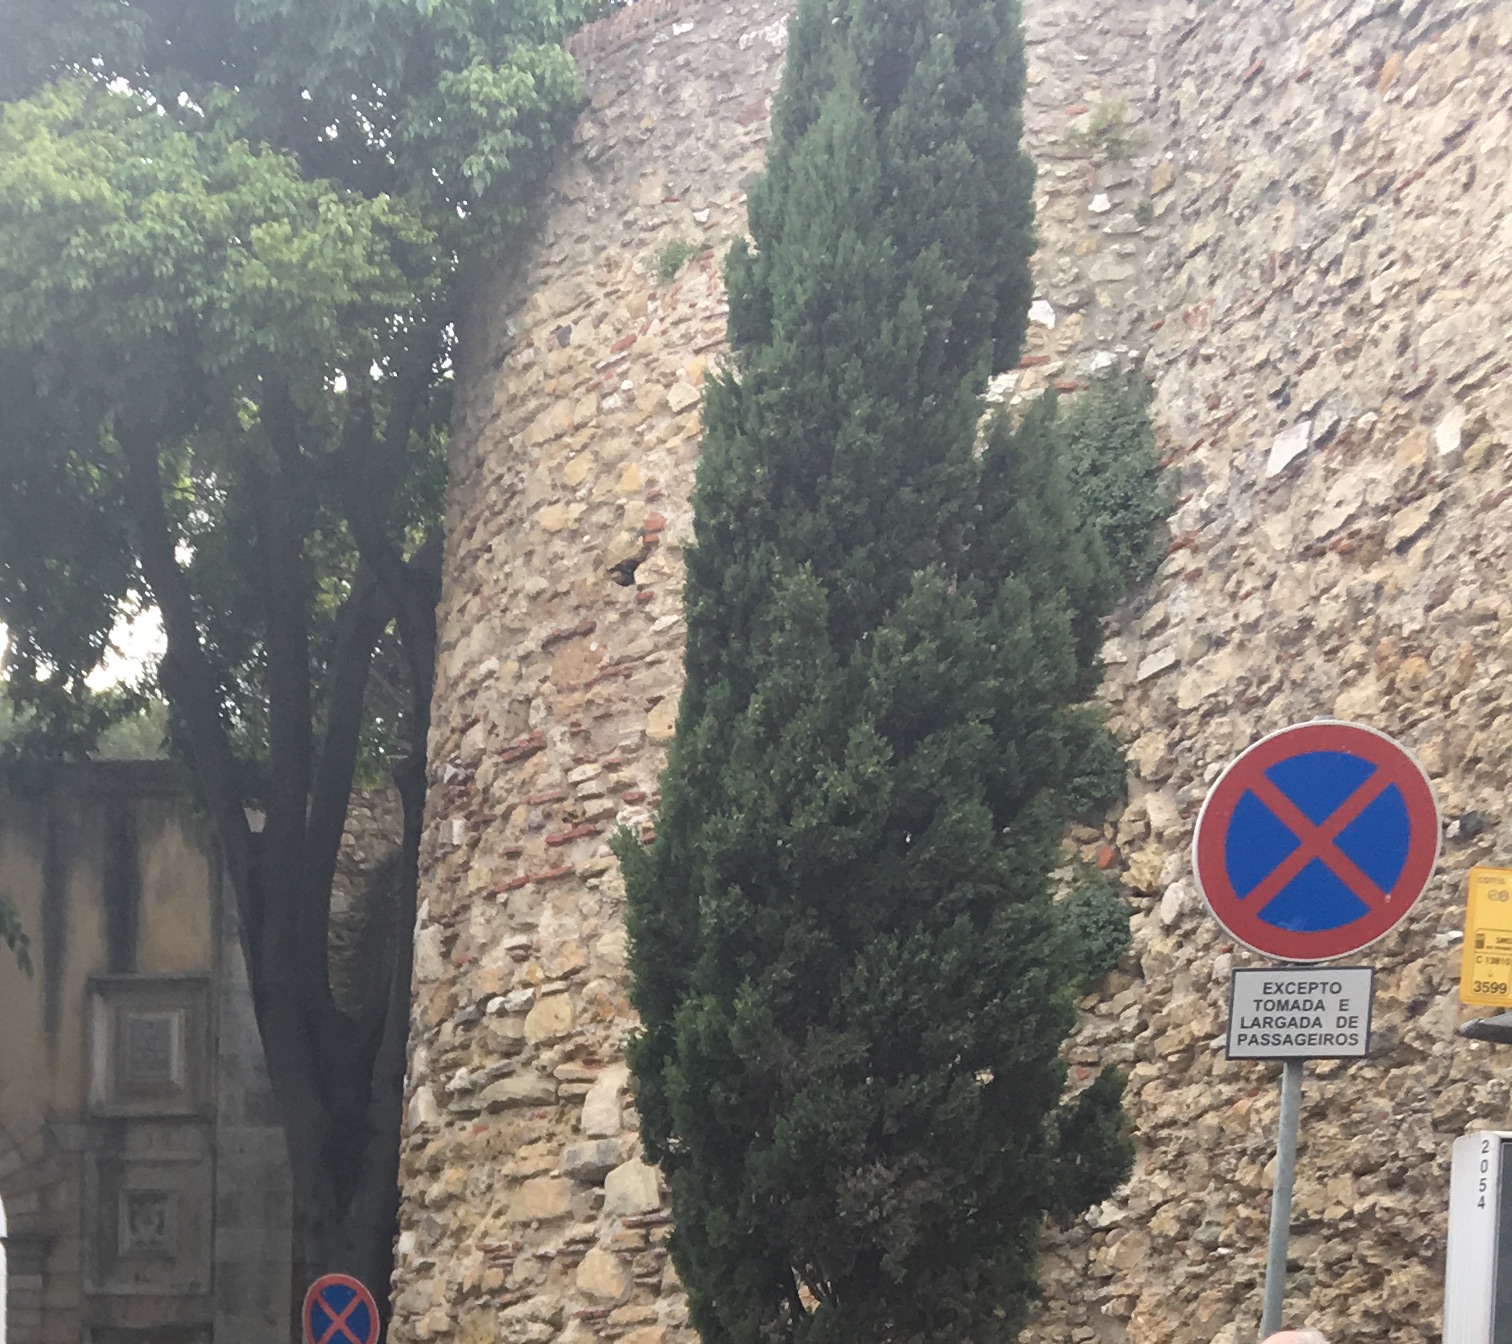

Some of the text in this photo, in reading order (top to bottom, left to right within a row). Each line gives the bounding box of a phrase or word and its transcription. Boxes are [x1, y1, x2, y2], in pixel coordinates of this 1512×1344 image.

[1263, 981, 1343, 995] EXCEPTO
[1473, 980, 1508, 994] 3599
[1253, 999, 1350, 1012] TOMADA E
[1240, 1016, 1359, 1029] LARGADA DE
[1237, 1033, 1359, 1046] PASSAGEIROS
